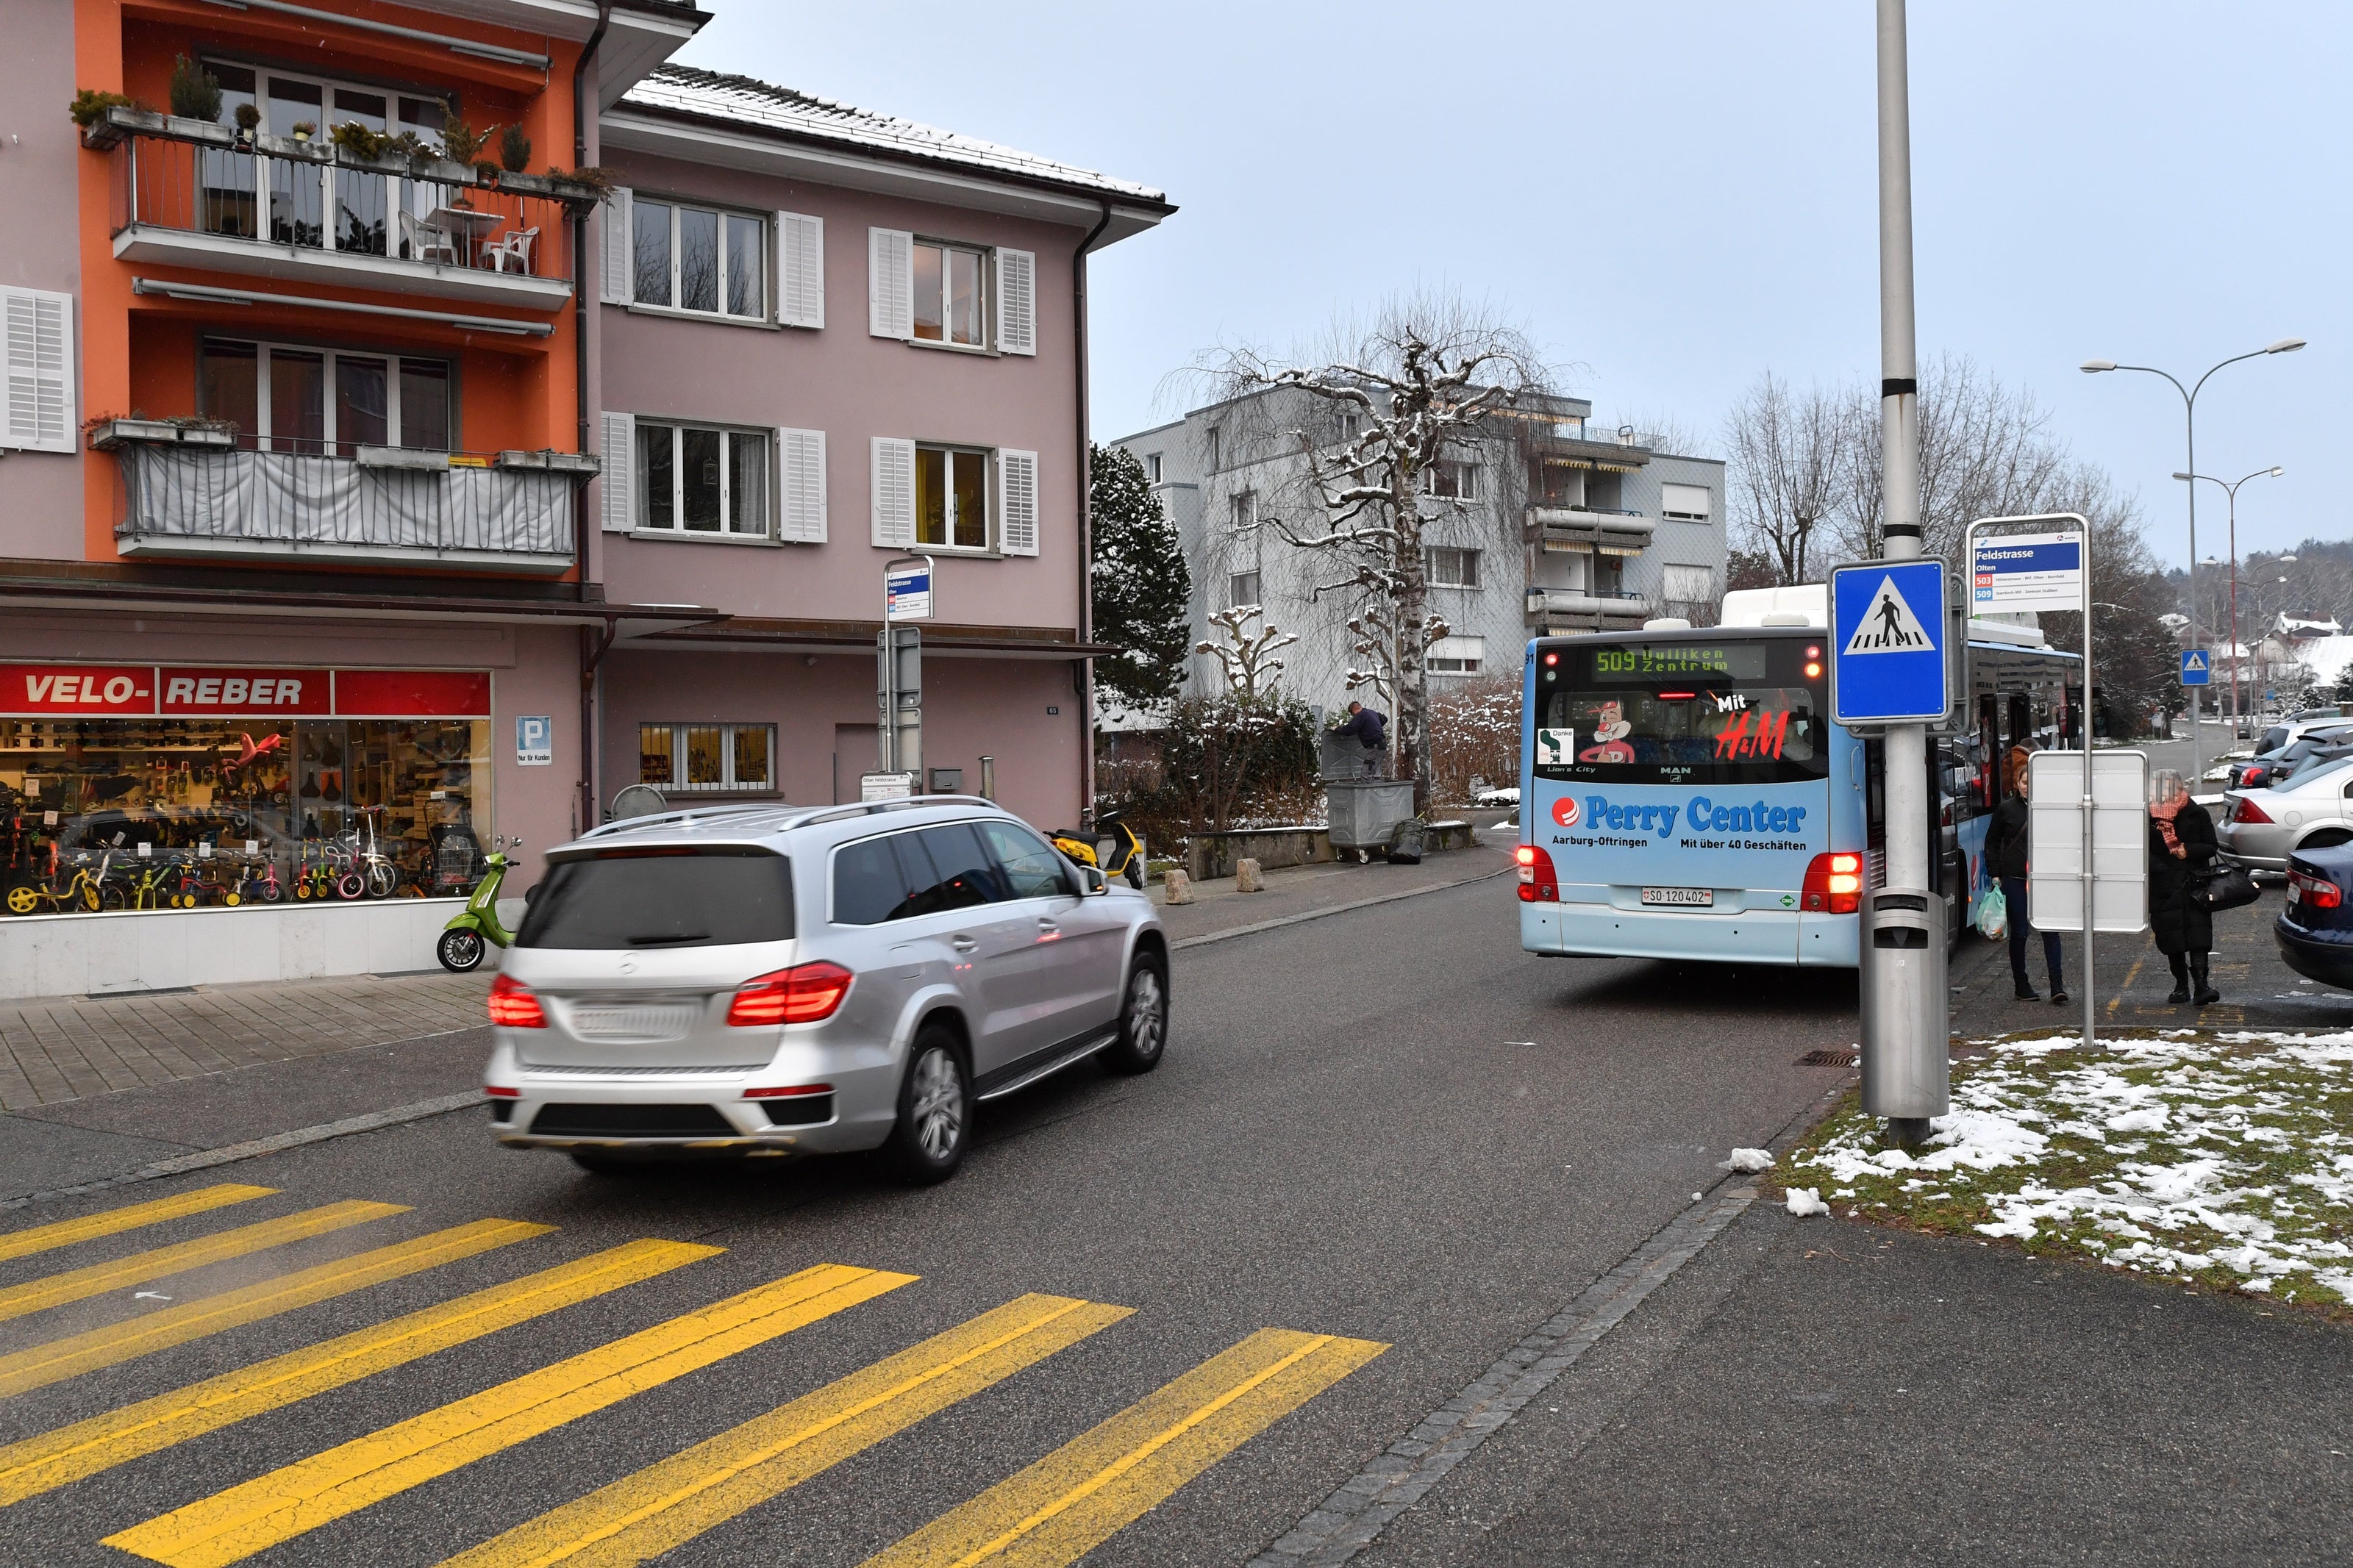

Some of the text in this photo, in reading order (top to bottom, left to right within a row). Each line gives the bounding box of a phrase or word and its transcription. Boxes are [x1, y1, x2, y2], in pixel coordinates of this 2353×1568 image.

[1976, 550, 2034, 560] Feldstrasse
[1977, 577, 1991, 585] 503
[1977, 590, 1991, 598] 509
[1597, 651, 1635, 672] 509
[1642, 661, 1728, 672] Zentrum
[25, 675, 302, 705] VELO- REBER
[1716, 694, 1746, 713] Mit
[524, 720, 543, 747] P
[1714, 710, 1790, 760] H&M
[1585, 795, 1807, 839] Perry Center
[1552, 835, 1648, 848] Aarburg-Oftringen
[1680, 838, 1807, 851] Mit über 40 Geschäften
